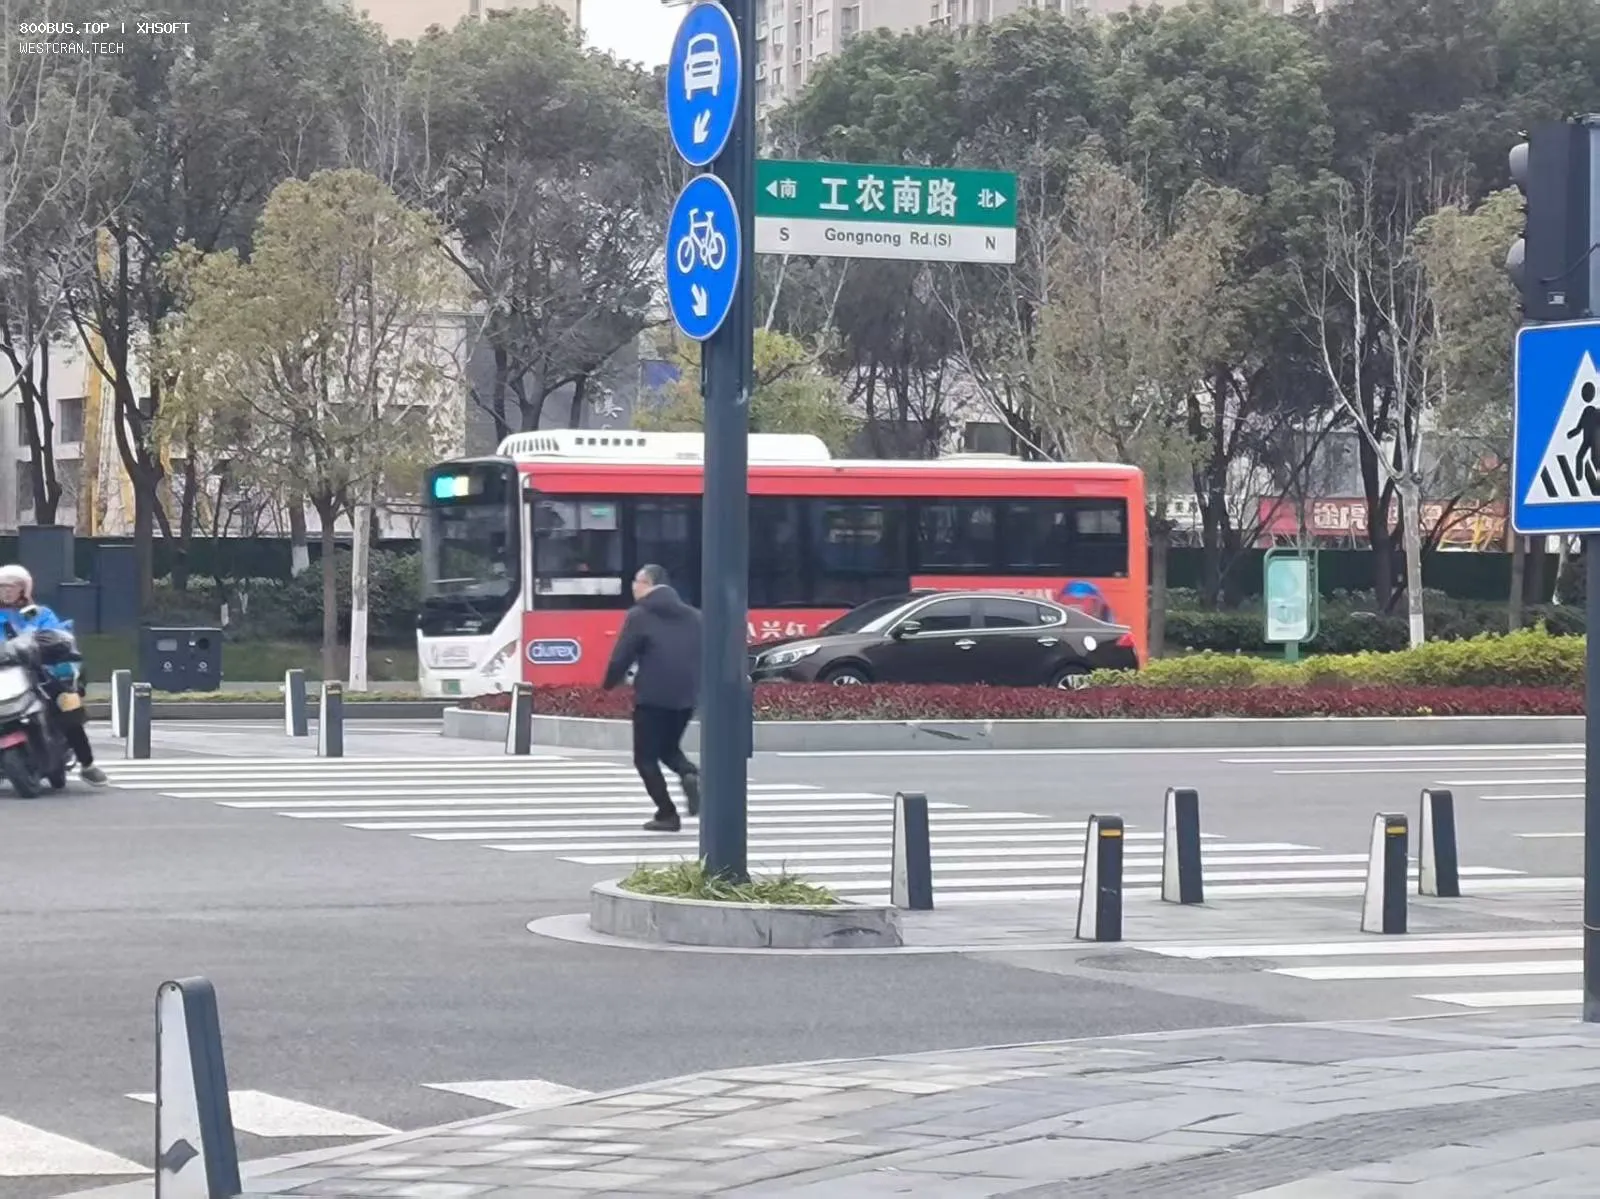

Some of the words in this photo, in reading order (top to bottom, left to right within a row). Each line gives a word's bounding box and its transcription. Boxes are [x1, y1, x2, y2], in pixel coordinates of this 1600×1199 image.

[779, 178, 797, 199] 南
[819, 174, 958, 217] 工农南路
[977, 188, 995, 208] 北
[779, 227, 790, 242] S
[824, 228, 901, 247] Gongnong
[985, 236, 996, 250] N
